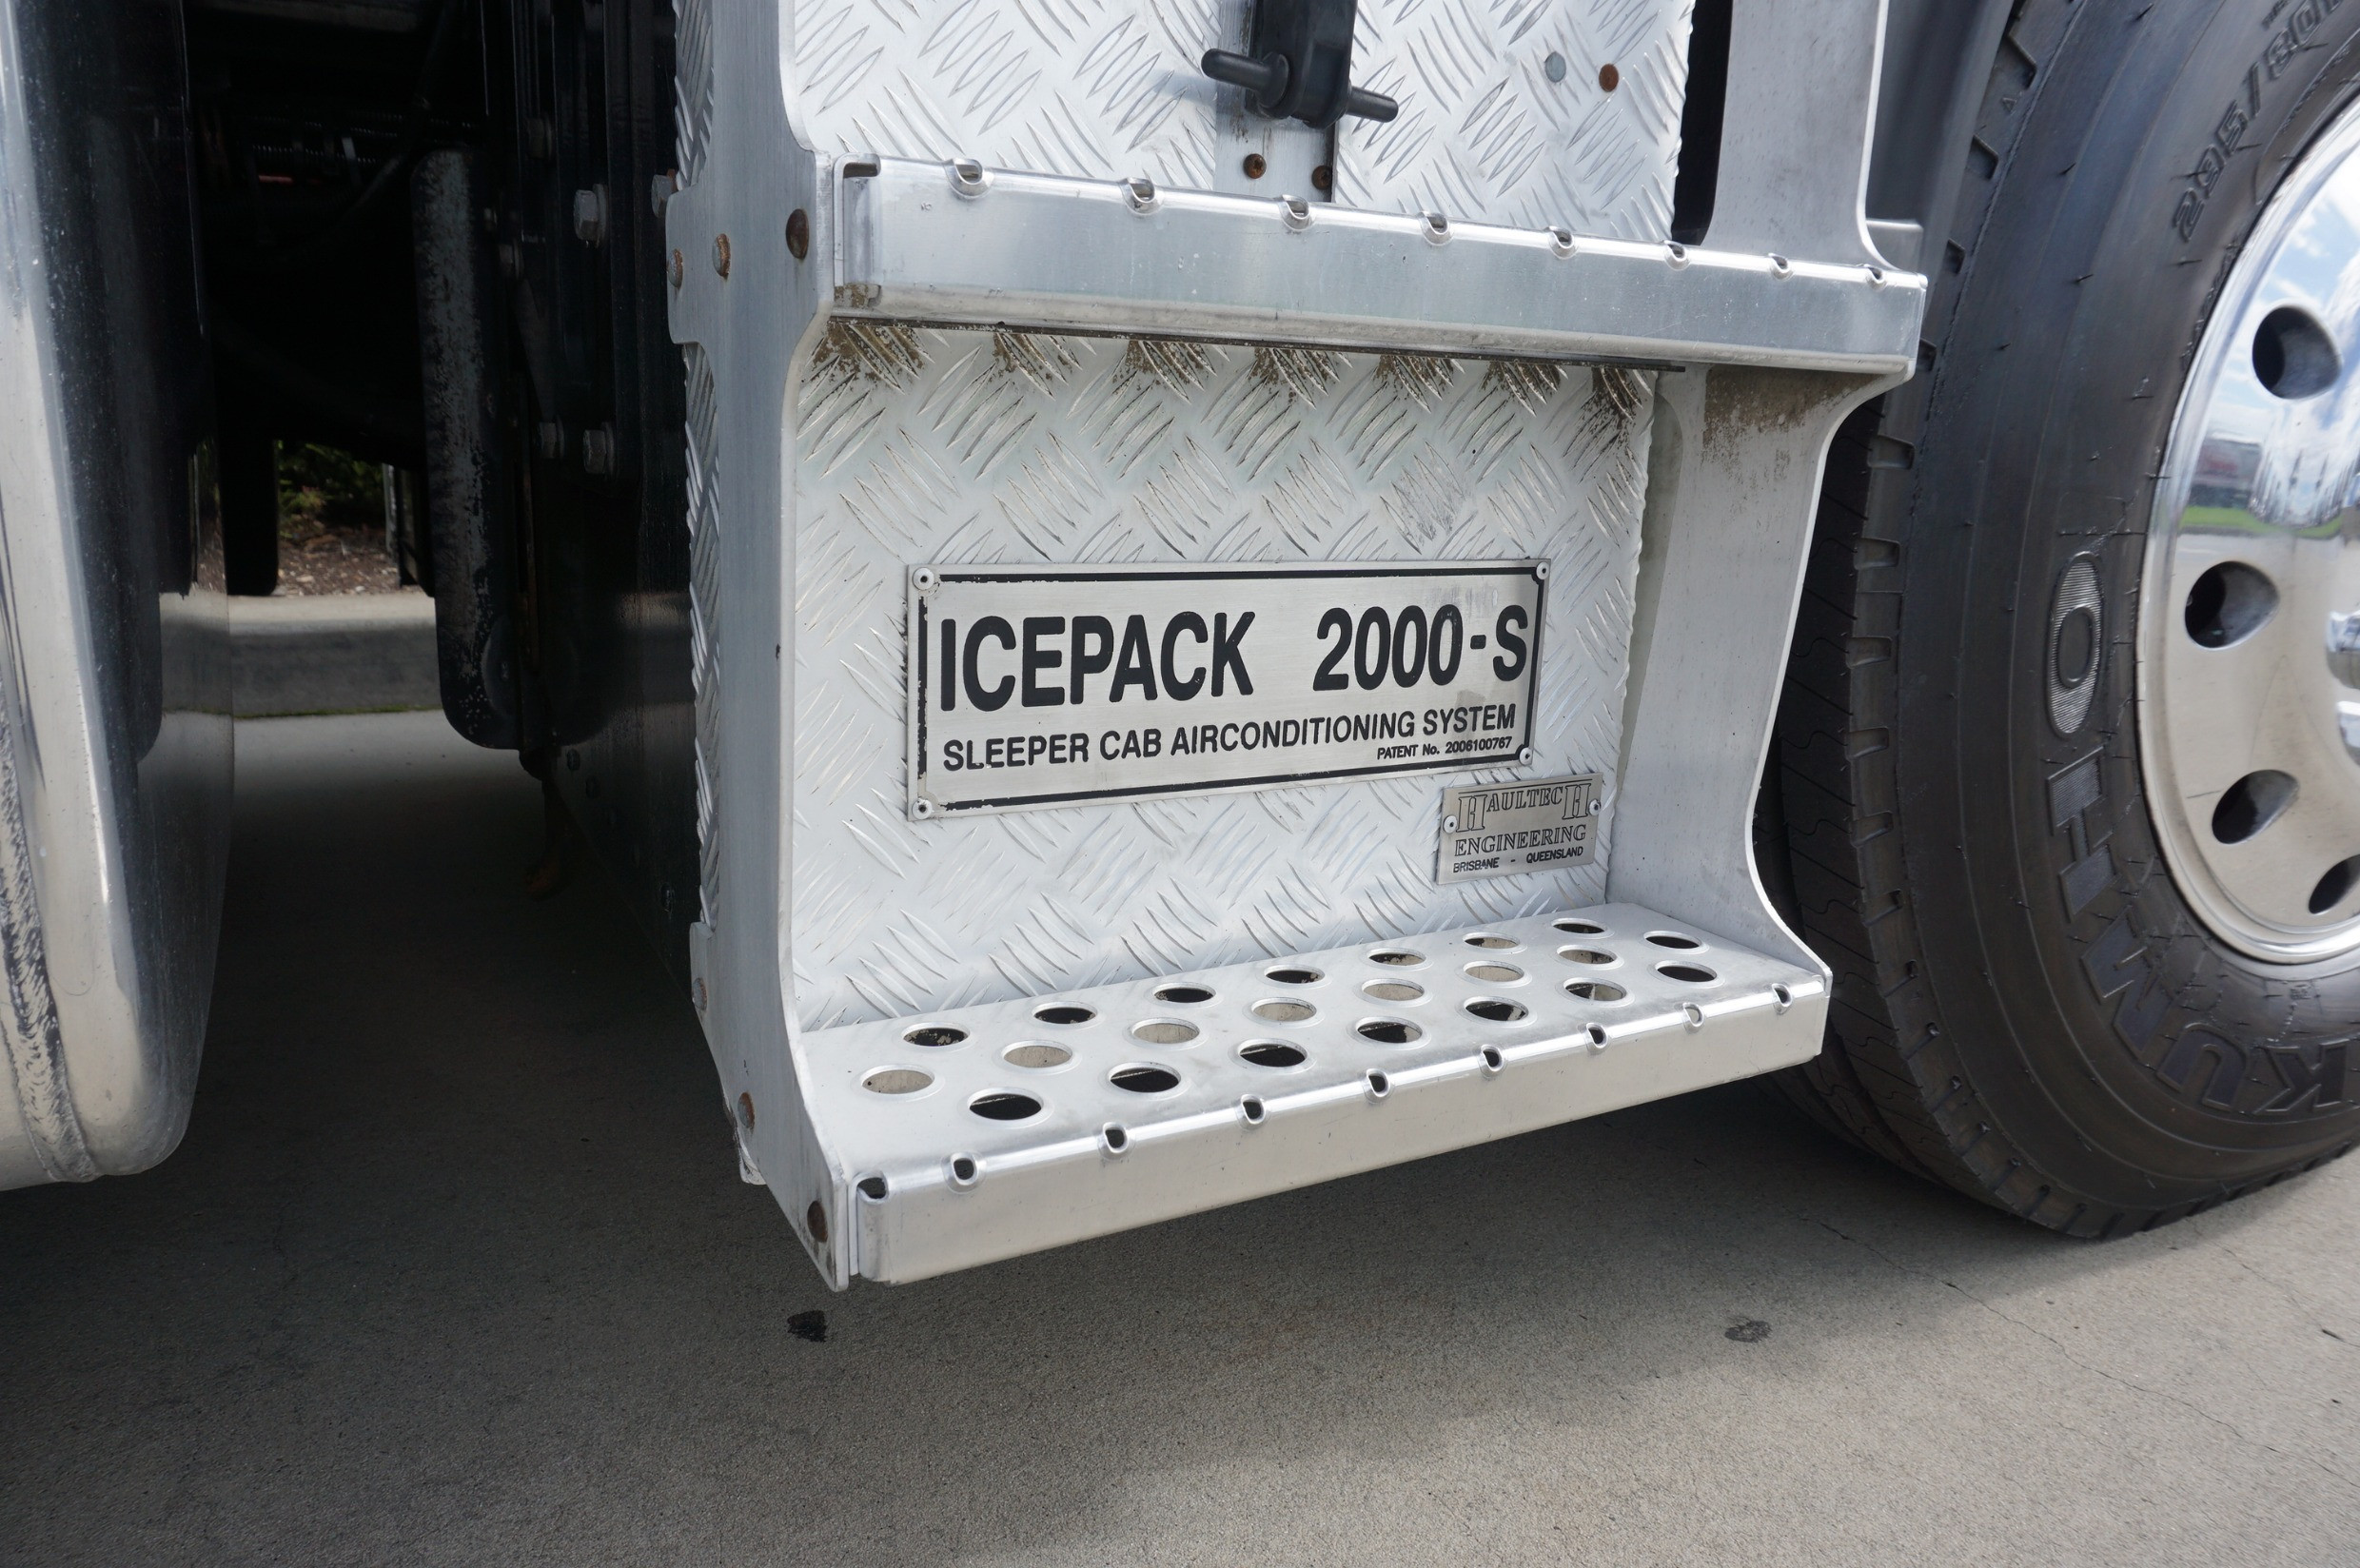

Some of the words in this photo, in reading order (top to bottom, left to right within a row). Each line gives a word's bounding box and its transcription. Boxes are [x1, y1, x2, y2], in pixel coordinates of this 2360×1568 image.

[940, 612, 1256, 712] ICEPACK
[1313, 604, 1528, 691] 2000-S
[943, 733, 1090, 771] SLEEPER
[1100, 729, 1161, 760] CAB
[1170, 712, 1415, 755] AIRCONDITIONING
[1423, 703, 1516, 735] SYSTEM
[1377, 744, 1418, 760] PATENT
[1423, 744, 1440, 756] No.
[1445, 736, 1512, 754] 2006100767
[1454, 825, 1587, 857] ENGINEERING
[2047, 550, 2348, 1114] KUMHO
[1453, 857, 1500, 873] BRISBANE
[1526, 847, 1584, 864] QUEENSLAND
